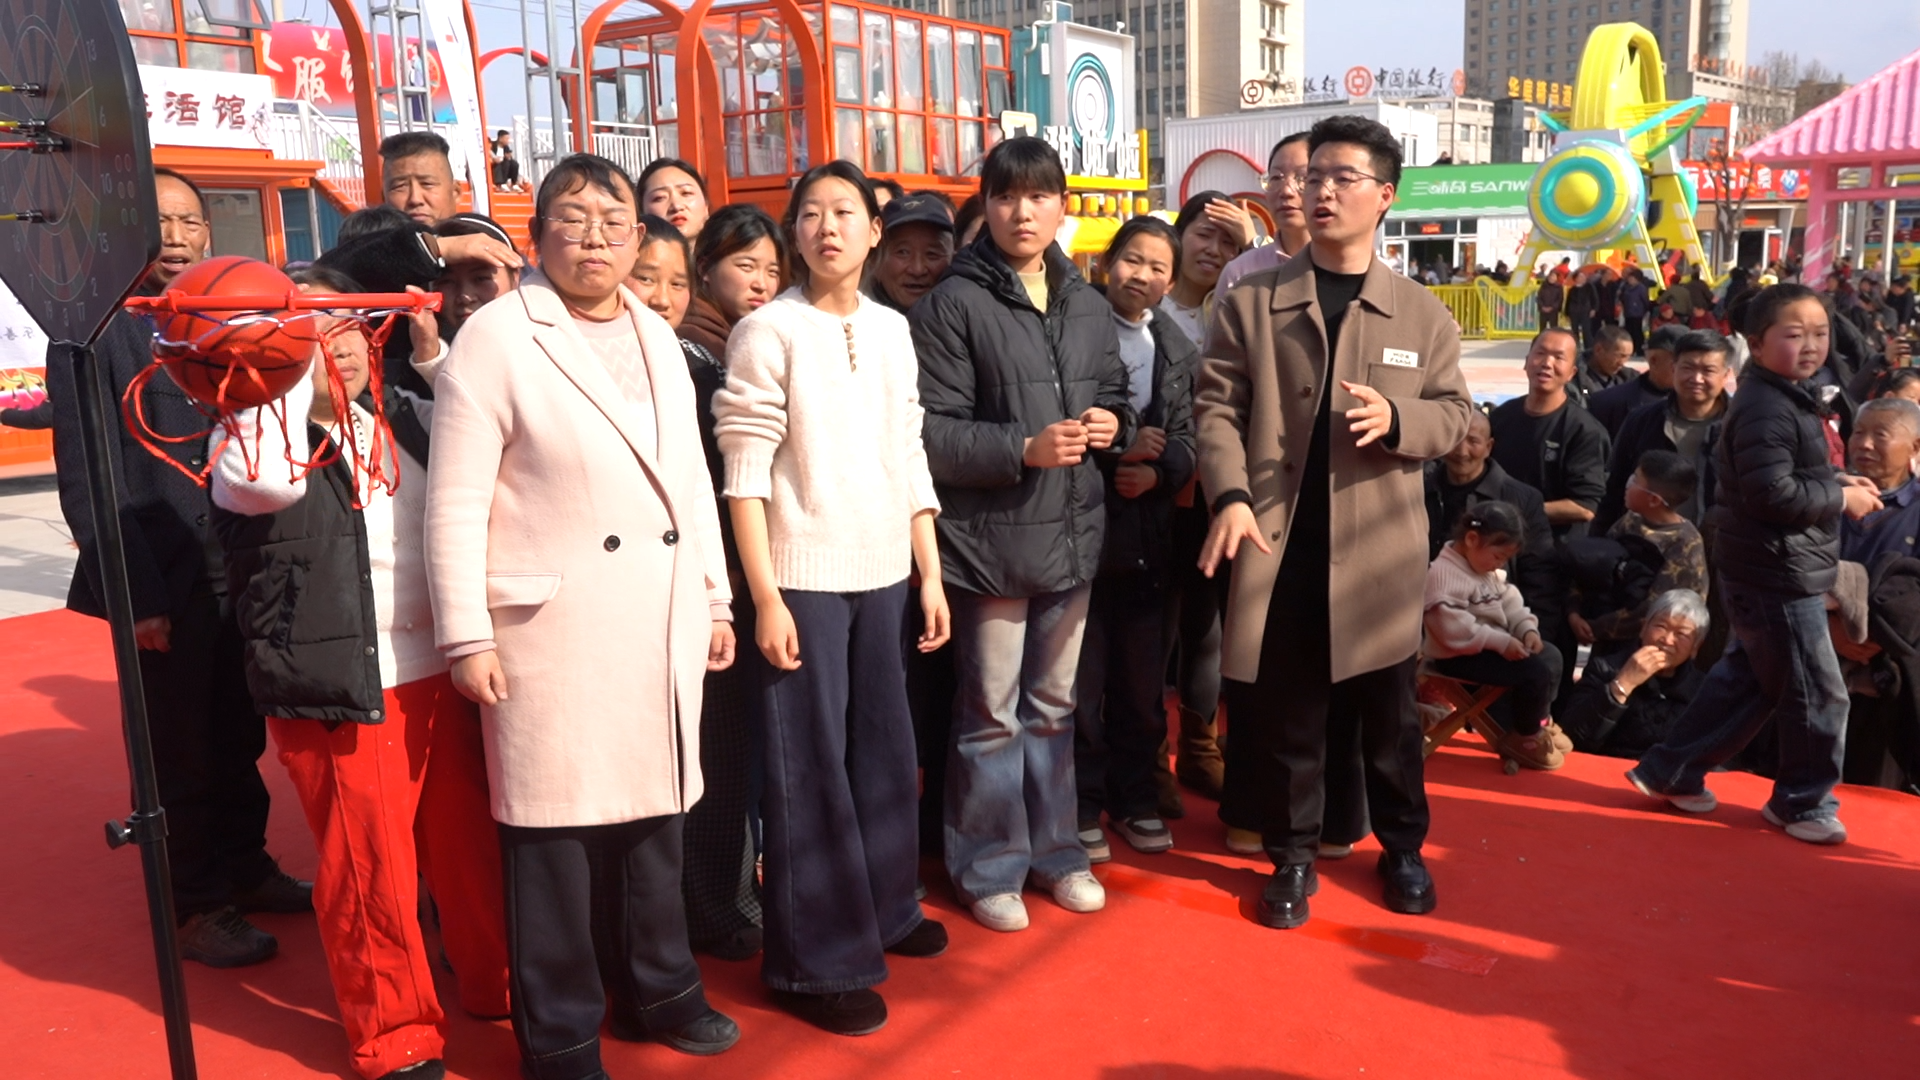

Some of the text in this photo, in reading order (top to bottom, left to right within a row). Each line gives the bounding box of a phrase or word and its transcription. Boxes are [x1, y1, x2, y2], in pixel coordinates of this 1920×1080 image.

[86, 39, 97, 62] 13
[100, 105, 107, 128] 6
[100, 172, 113, 195] 10
[1470, 180, 1530, 193] SANW
[97, 232, 109, 253] 15
[90, 277, 98, 297] 2
